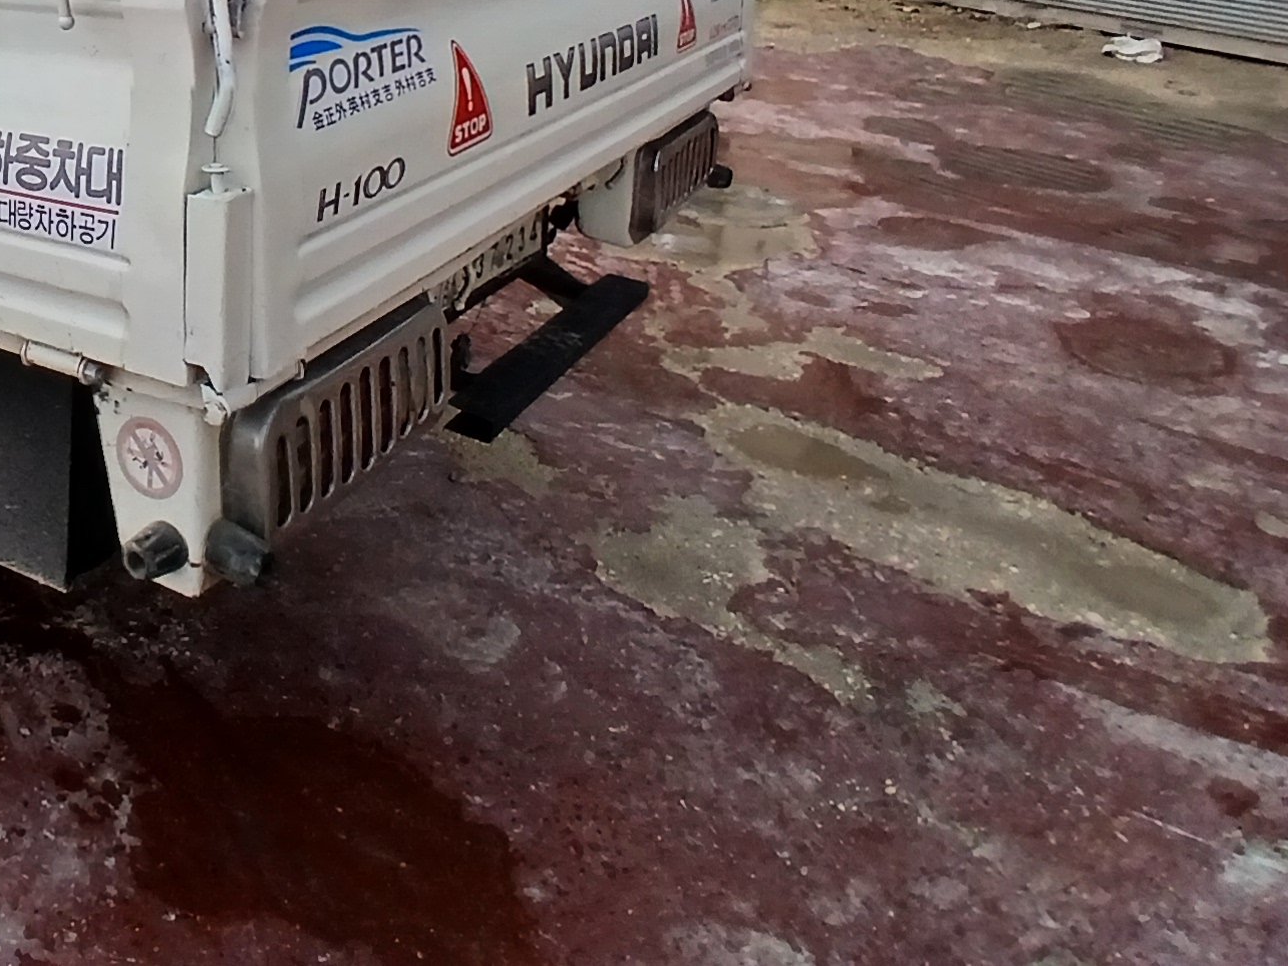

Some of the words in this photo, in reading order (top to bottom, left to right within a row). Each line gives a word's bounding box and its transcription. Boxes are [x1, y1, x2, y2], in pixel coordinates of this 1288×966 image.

[296, 34, 427, 129] PORTER
[526, 14, 659, 116] HYUNDAI
[454, 113, 487, 144] STOP
[316, 157, 405, 222] H-100
